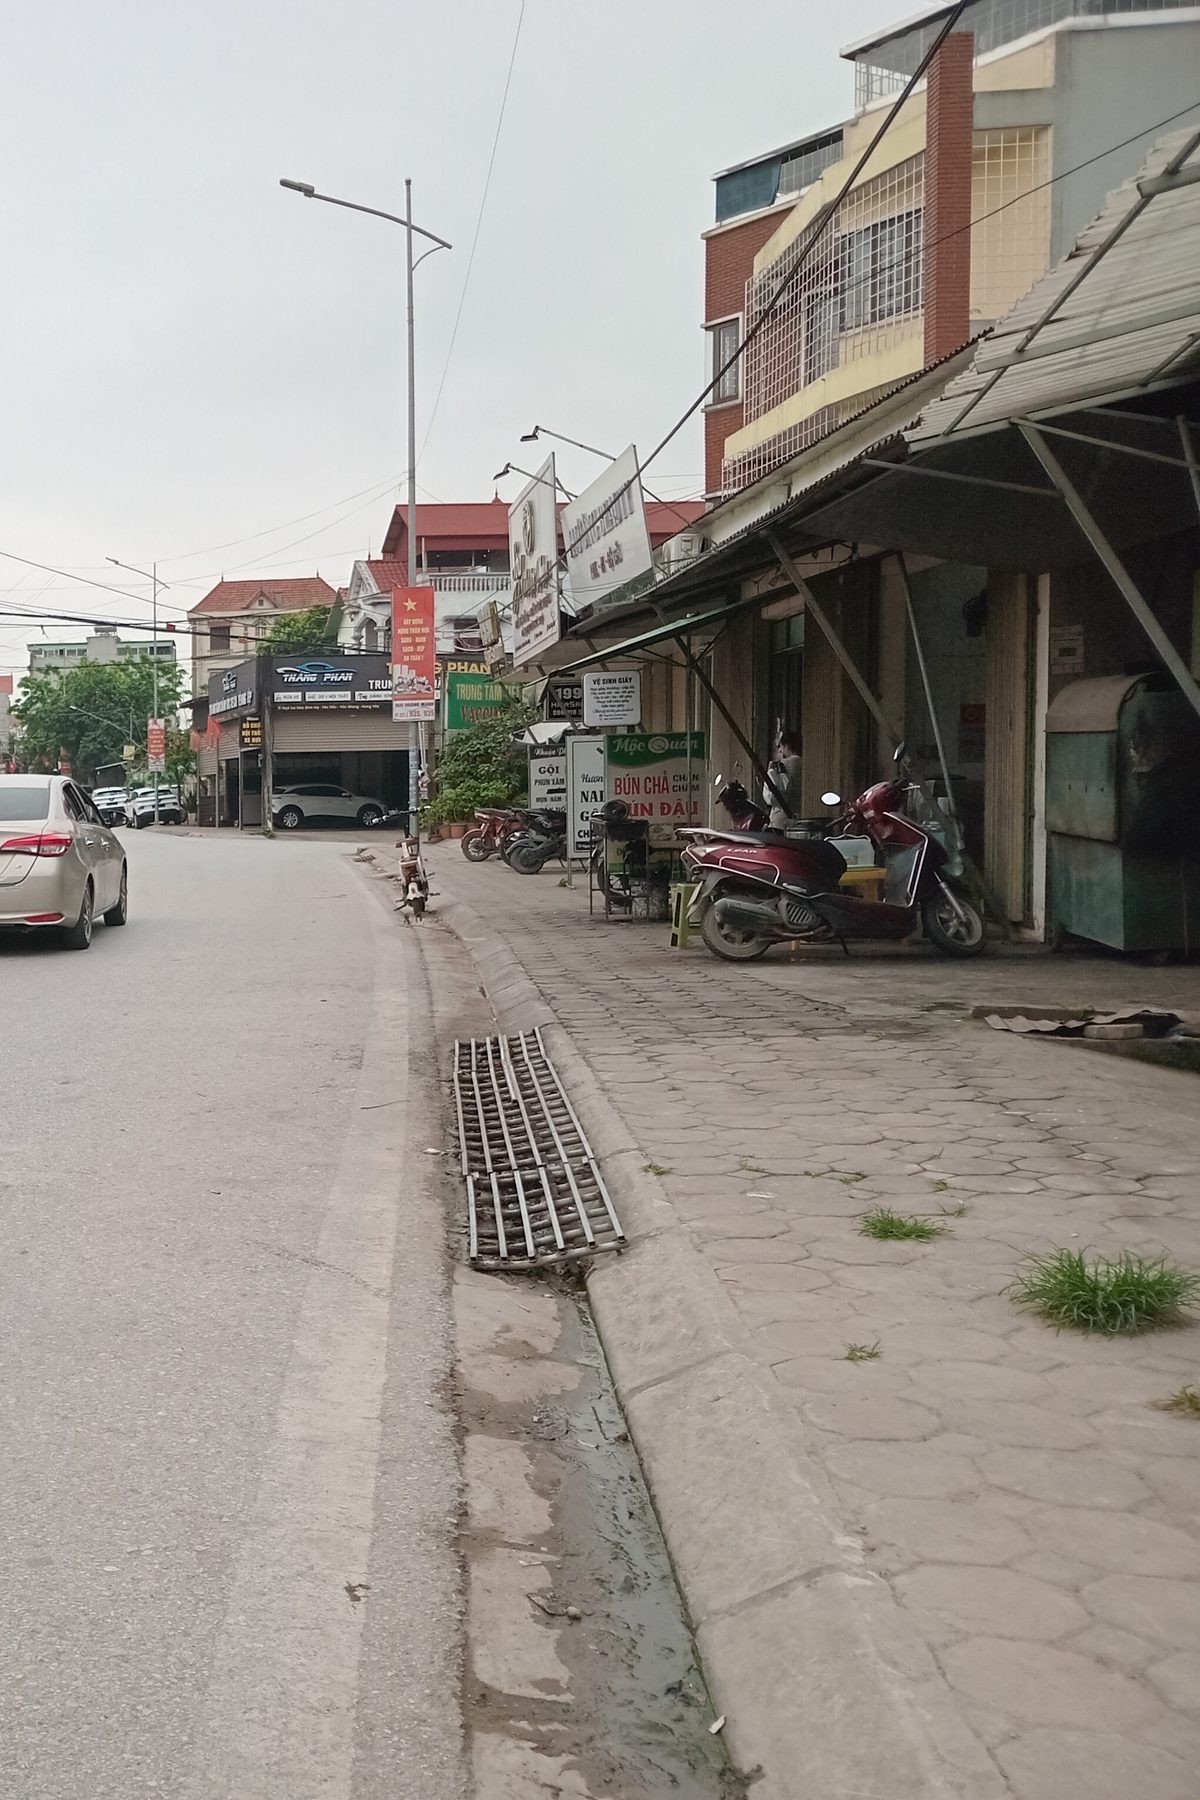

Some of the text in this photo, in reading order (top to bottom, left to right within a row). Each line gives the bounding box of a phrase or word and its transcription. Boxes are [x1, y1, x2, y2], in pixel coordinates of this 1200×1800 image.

[538, 764, 560, 777] GỘI
[614, 773, 640, 796] BÚN
[644, 770, 670, 795] CHẢ
